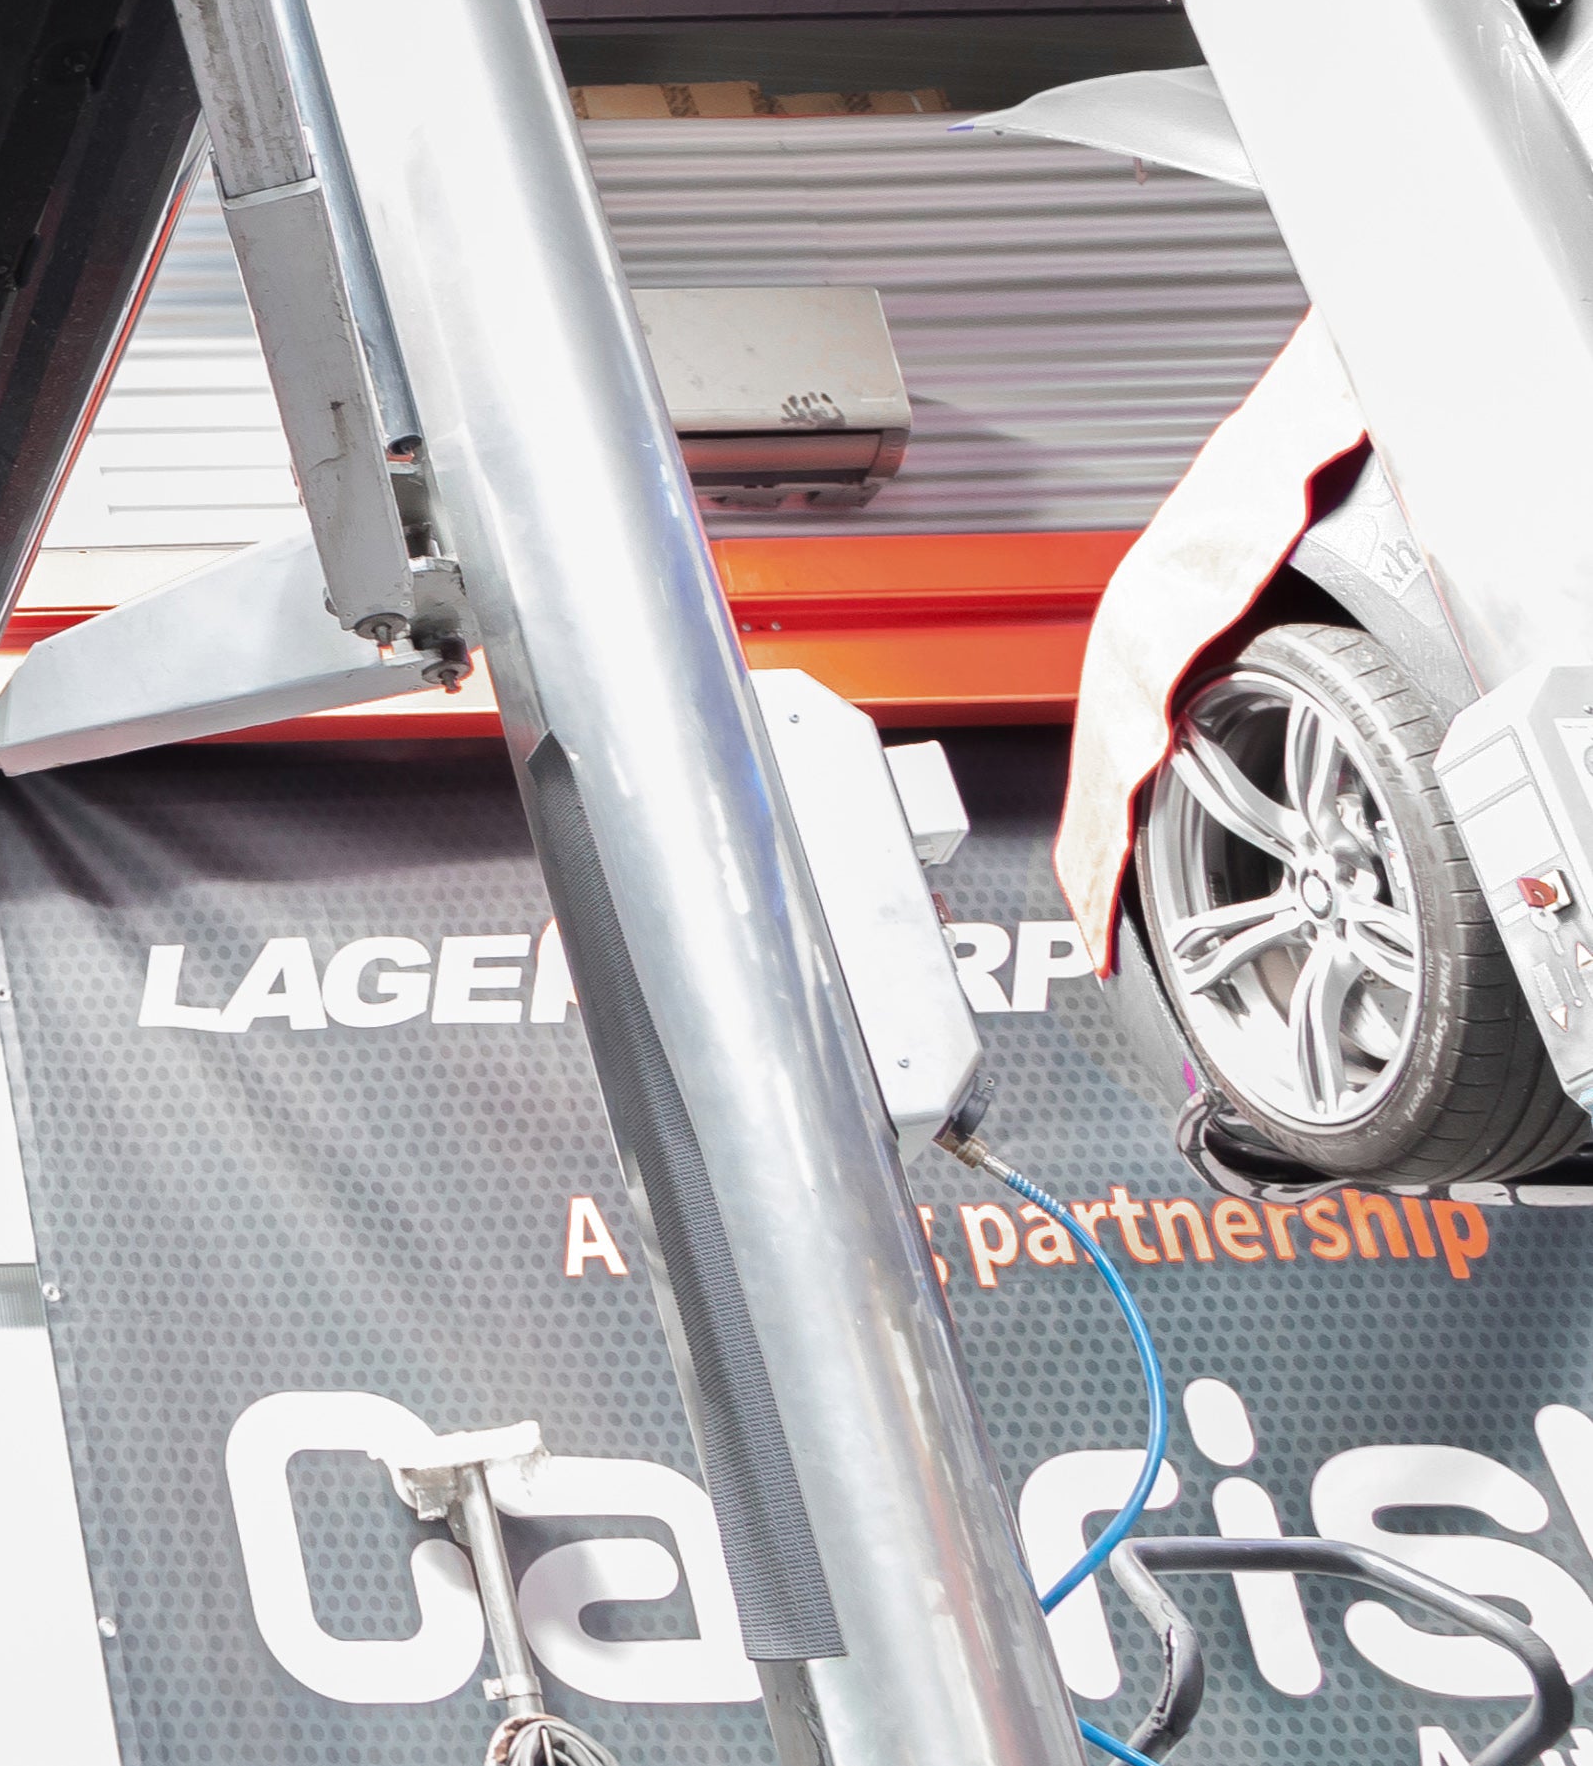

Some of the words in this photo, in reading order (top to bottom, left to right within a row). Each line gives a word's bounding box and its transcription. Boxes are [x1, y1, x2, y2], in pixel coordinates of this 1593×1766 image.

[1286, 647, 1378, 742] ICHELIN
[1436, 949, 1453, 1008] Pilot
[1427, 1012, 1450, 1072] Super
[1403, 1074, 1435, 1121] Sport
[958, 1185, 1489, 1289] partnership
